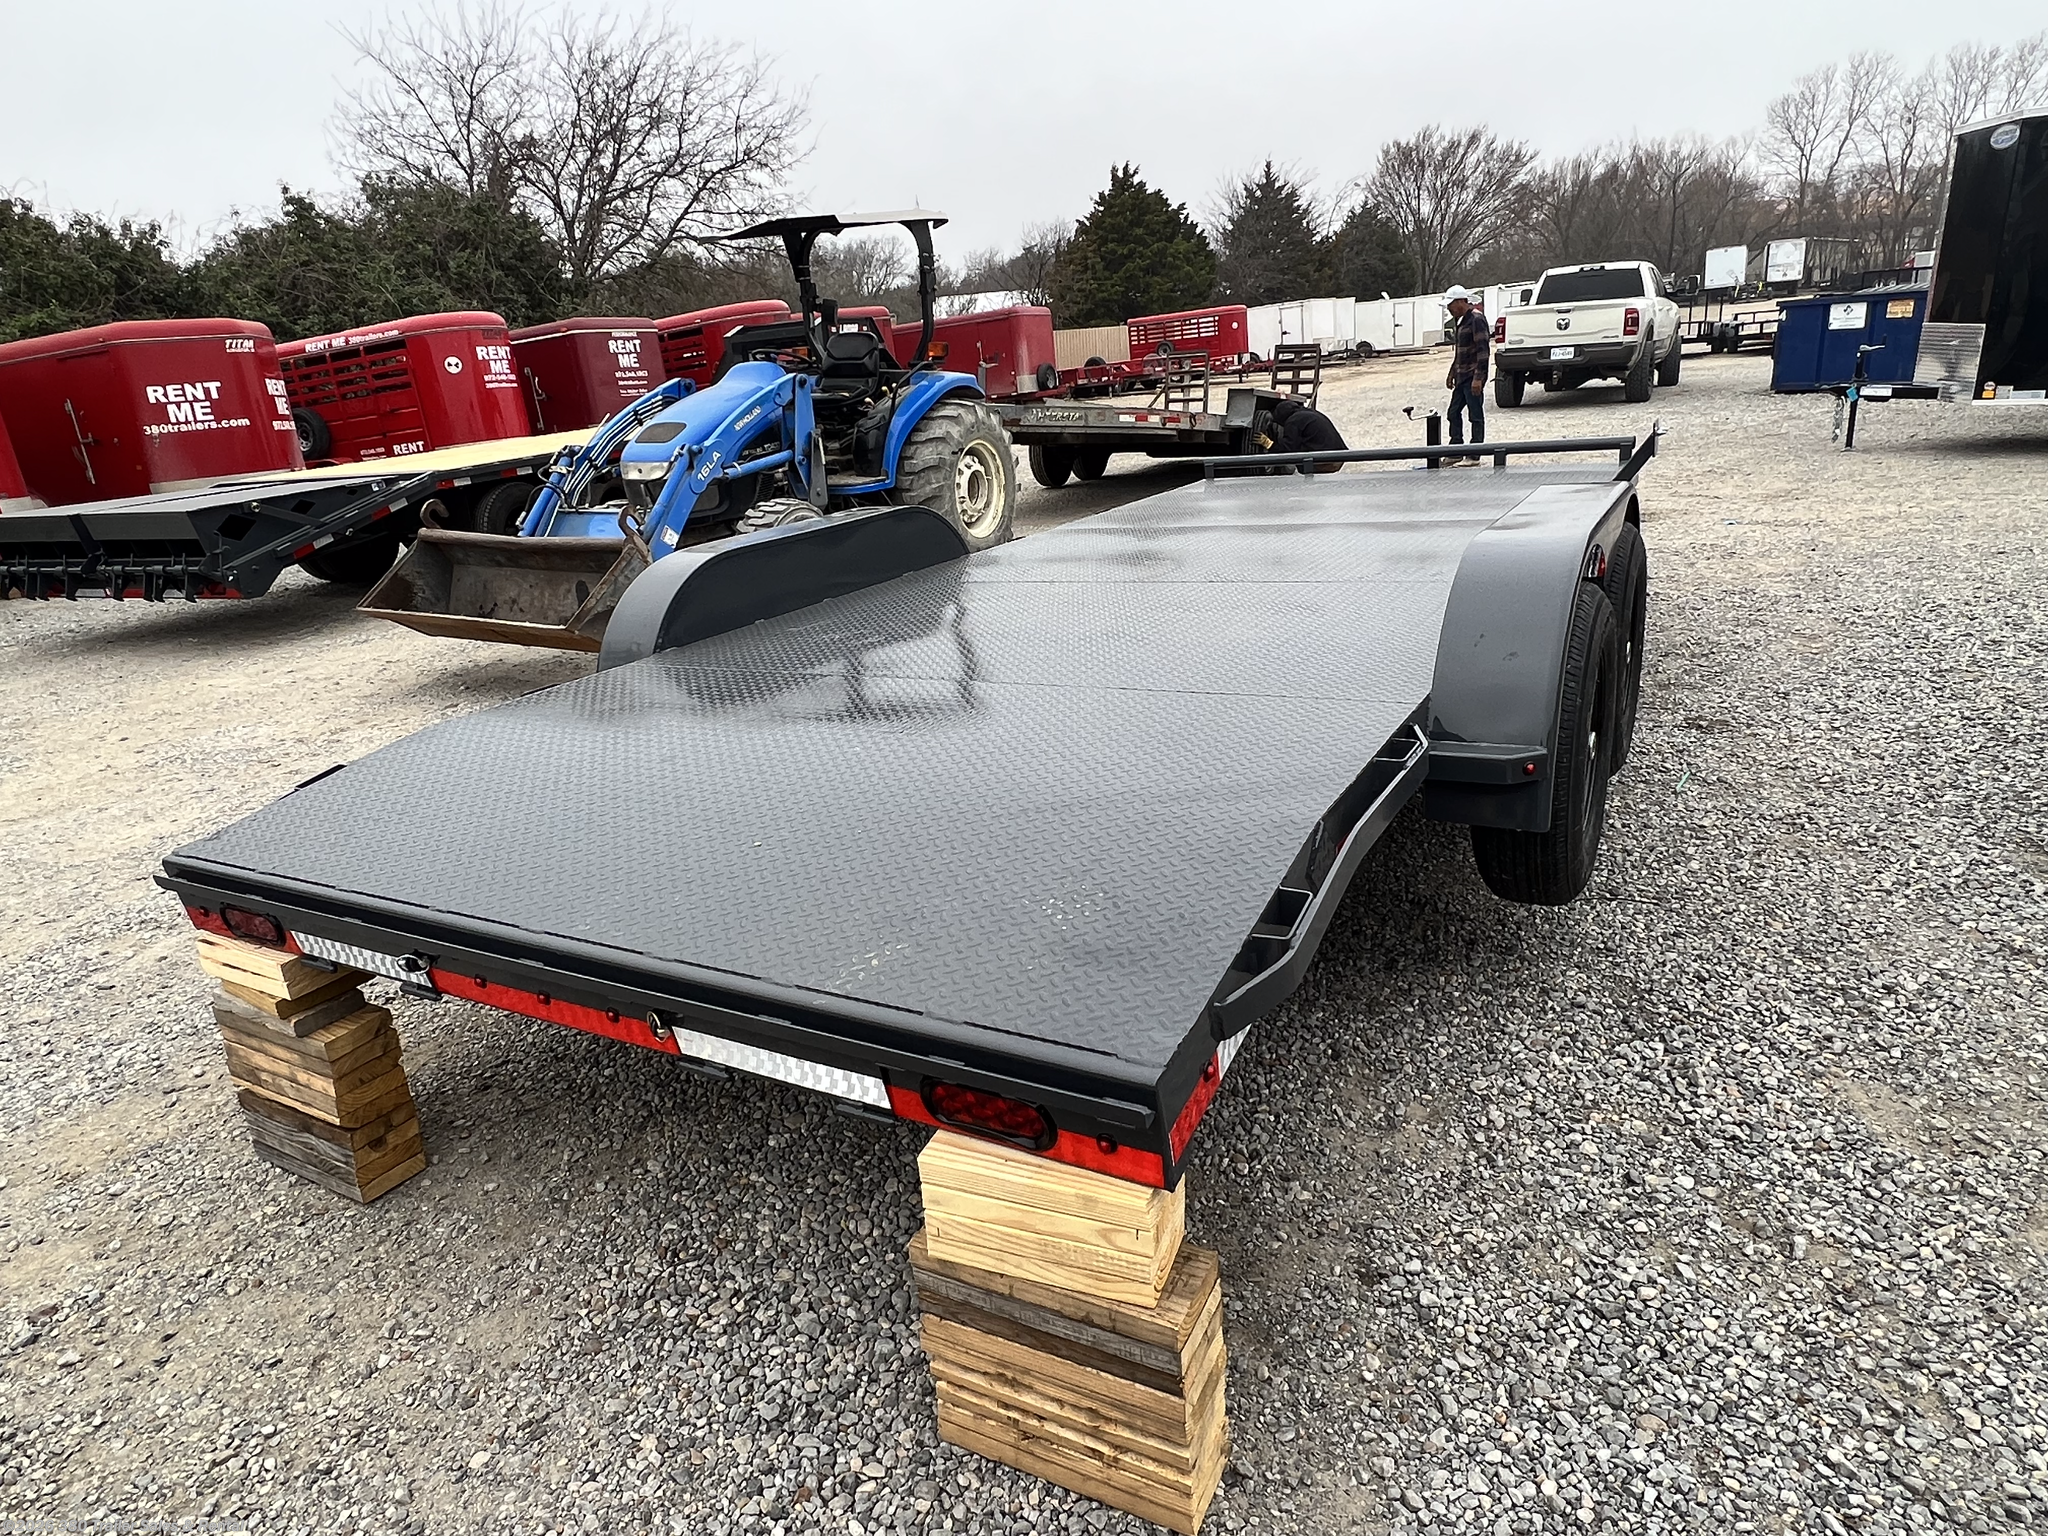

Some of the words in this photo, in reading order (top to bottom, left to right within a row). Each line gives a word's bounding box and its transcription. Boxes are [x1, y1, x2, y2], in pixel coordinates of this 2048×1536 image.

[304, 340, 330, 353] RENT
[331, 336, 347, 348] ME
[475, 345, 511, 360] RENT
[608, 339, 641, 354] RENT
[489, 360, 511, 374] ME
[617, 353, 640, 368] ME
[145, 381, 221, 404] RENT
[265, 378, 288, 396] RENT
[167, 401, 215, 423] ME
[274, 396, 291, 415] ME
[143, 418, 251, 435] 380trailers.com
[393, 441, 425, 455] RENT
[697, 451, 721, 481] 16LA
